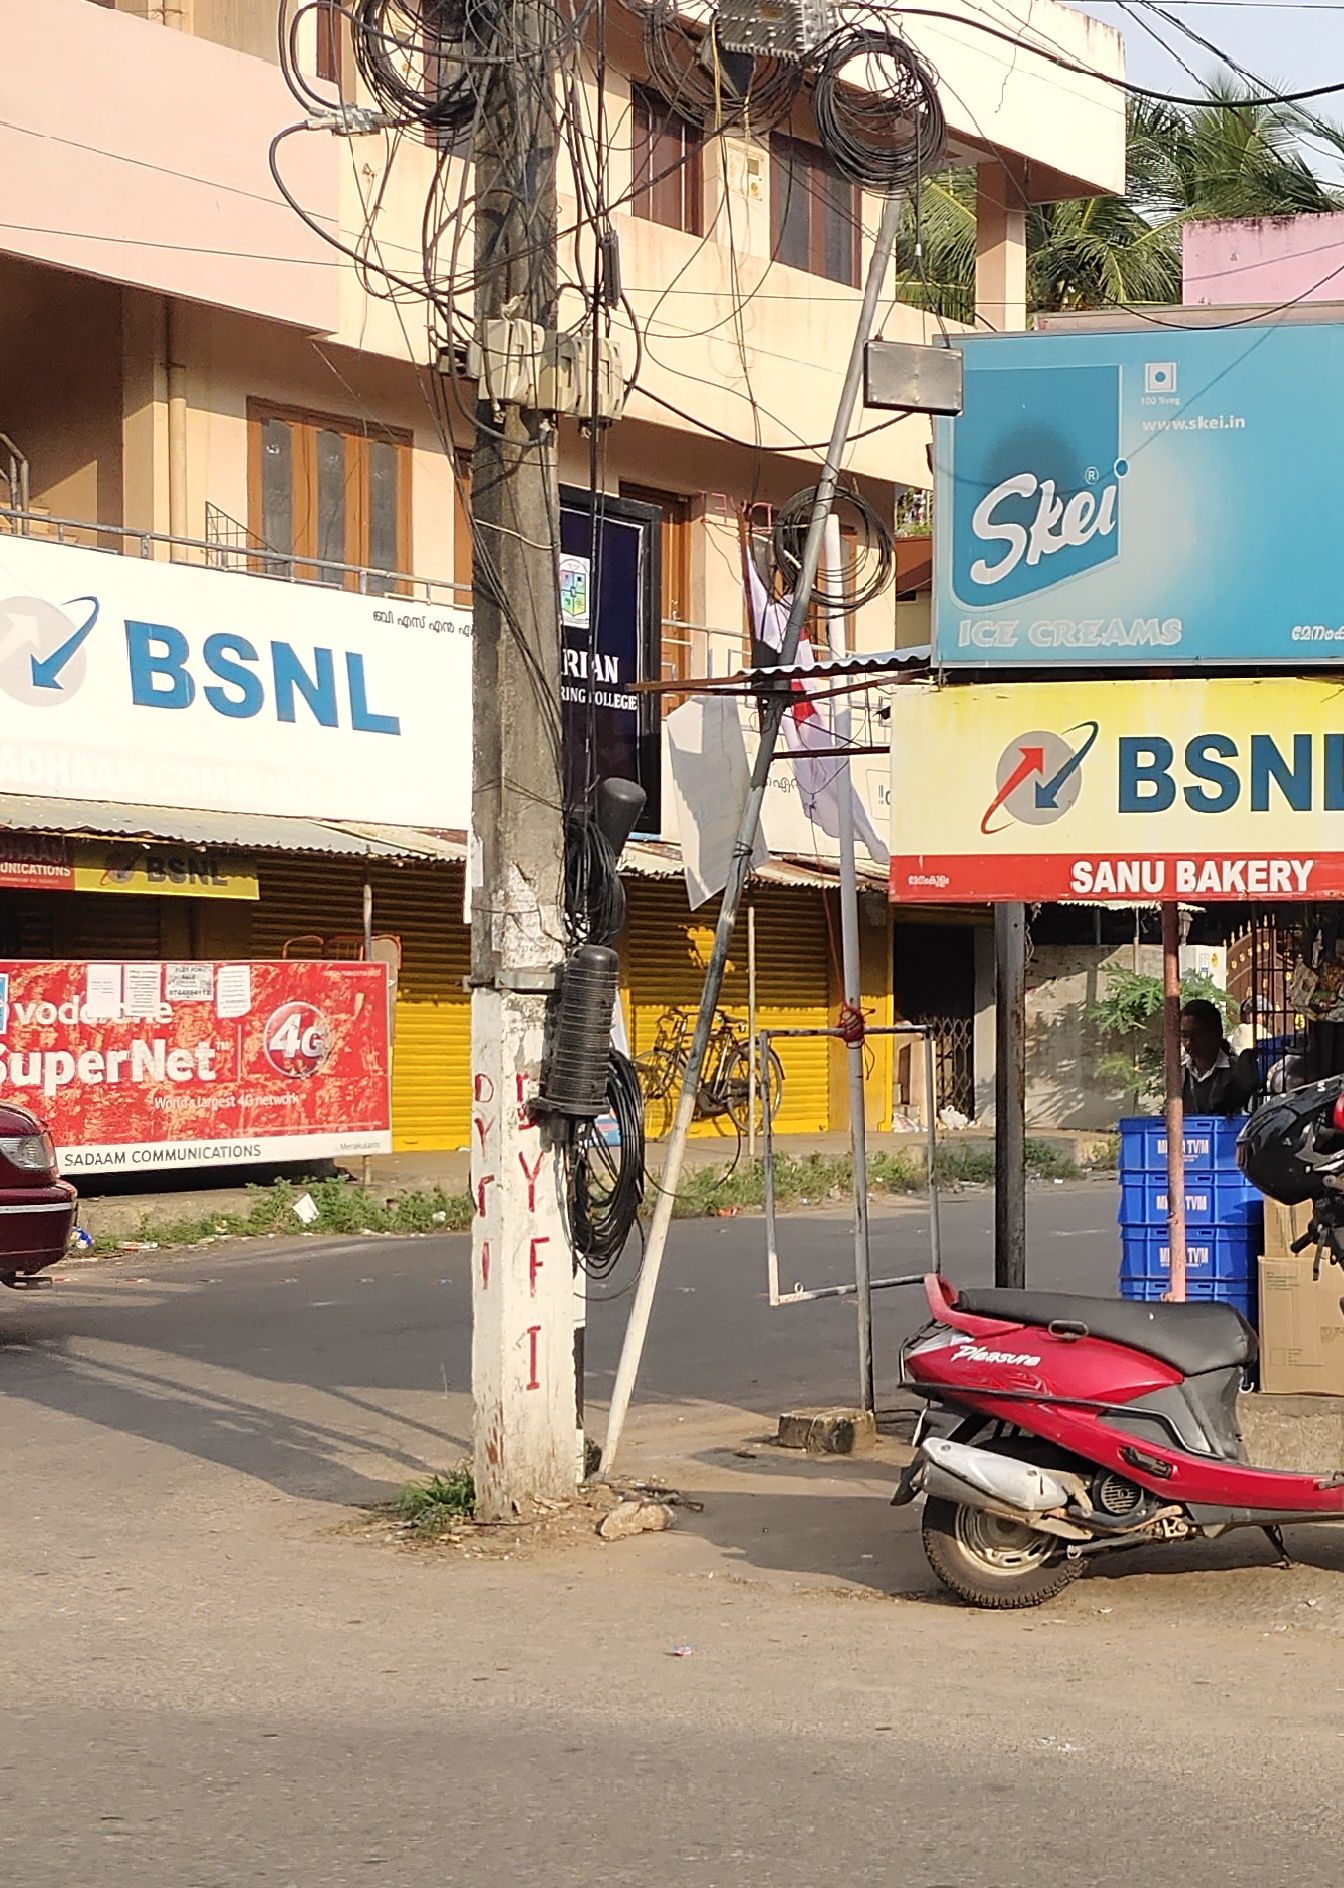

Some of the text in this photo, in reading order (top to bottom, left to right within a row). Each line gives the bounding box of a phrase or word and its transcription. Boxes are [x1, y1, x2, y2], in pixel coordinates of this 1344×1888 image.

[1142, 415, 1246, 431] www.skei.in
[970, 458, 1130, 586] Skei
[957, 617, 1184, 648] ICE CREAMS
[123, 619, 401, 736] BSNL
[561, 648, 619, 685] RIAN
[588, 688, 639, 713] OLLEGE
[146, 856, 229, 886] BSNL
[1071, 859, 1314, 893] SANU BAKERY
[65, 1145, 262, 1167] SADAAM COMMUNICATIONS
[950, 1345, 1041, 1366] Pleasure
